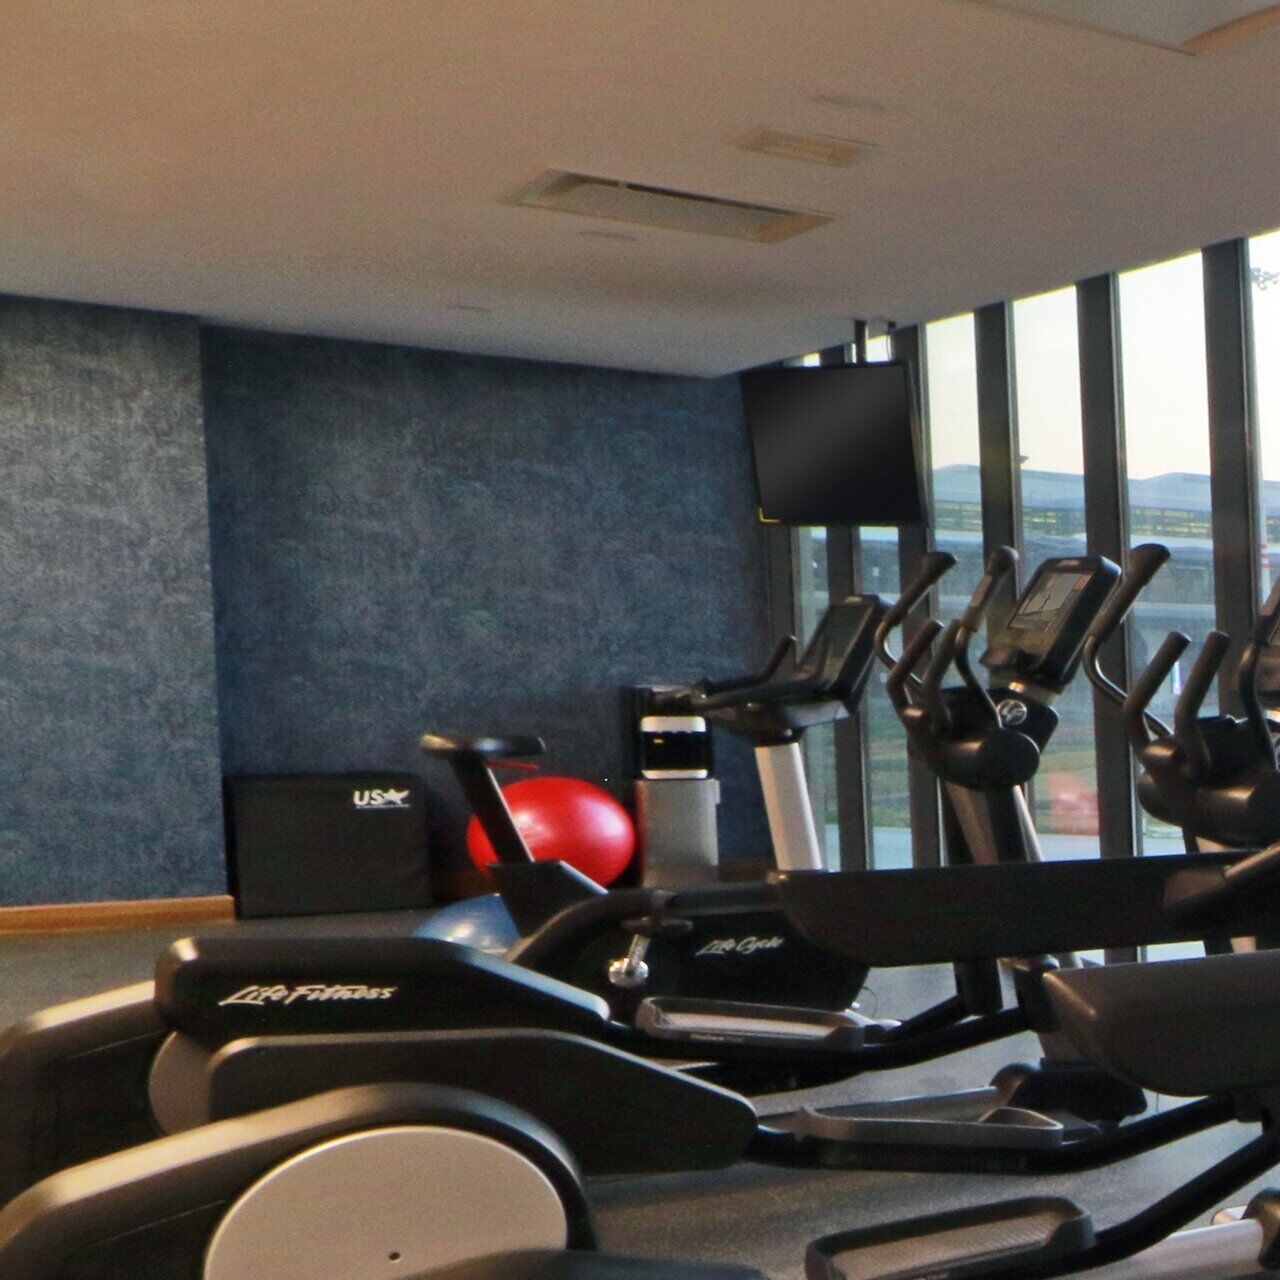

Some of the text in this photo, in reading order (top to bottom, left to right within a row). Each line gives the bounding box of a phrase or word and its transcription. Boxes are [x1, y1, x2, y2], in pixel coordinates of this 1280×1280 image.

[695, 938, 736, 956] Life
[218, 984, 396, 1006] Life Fitness
